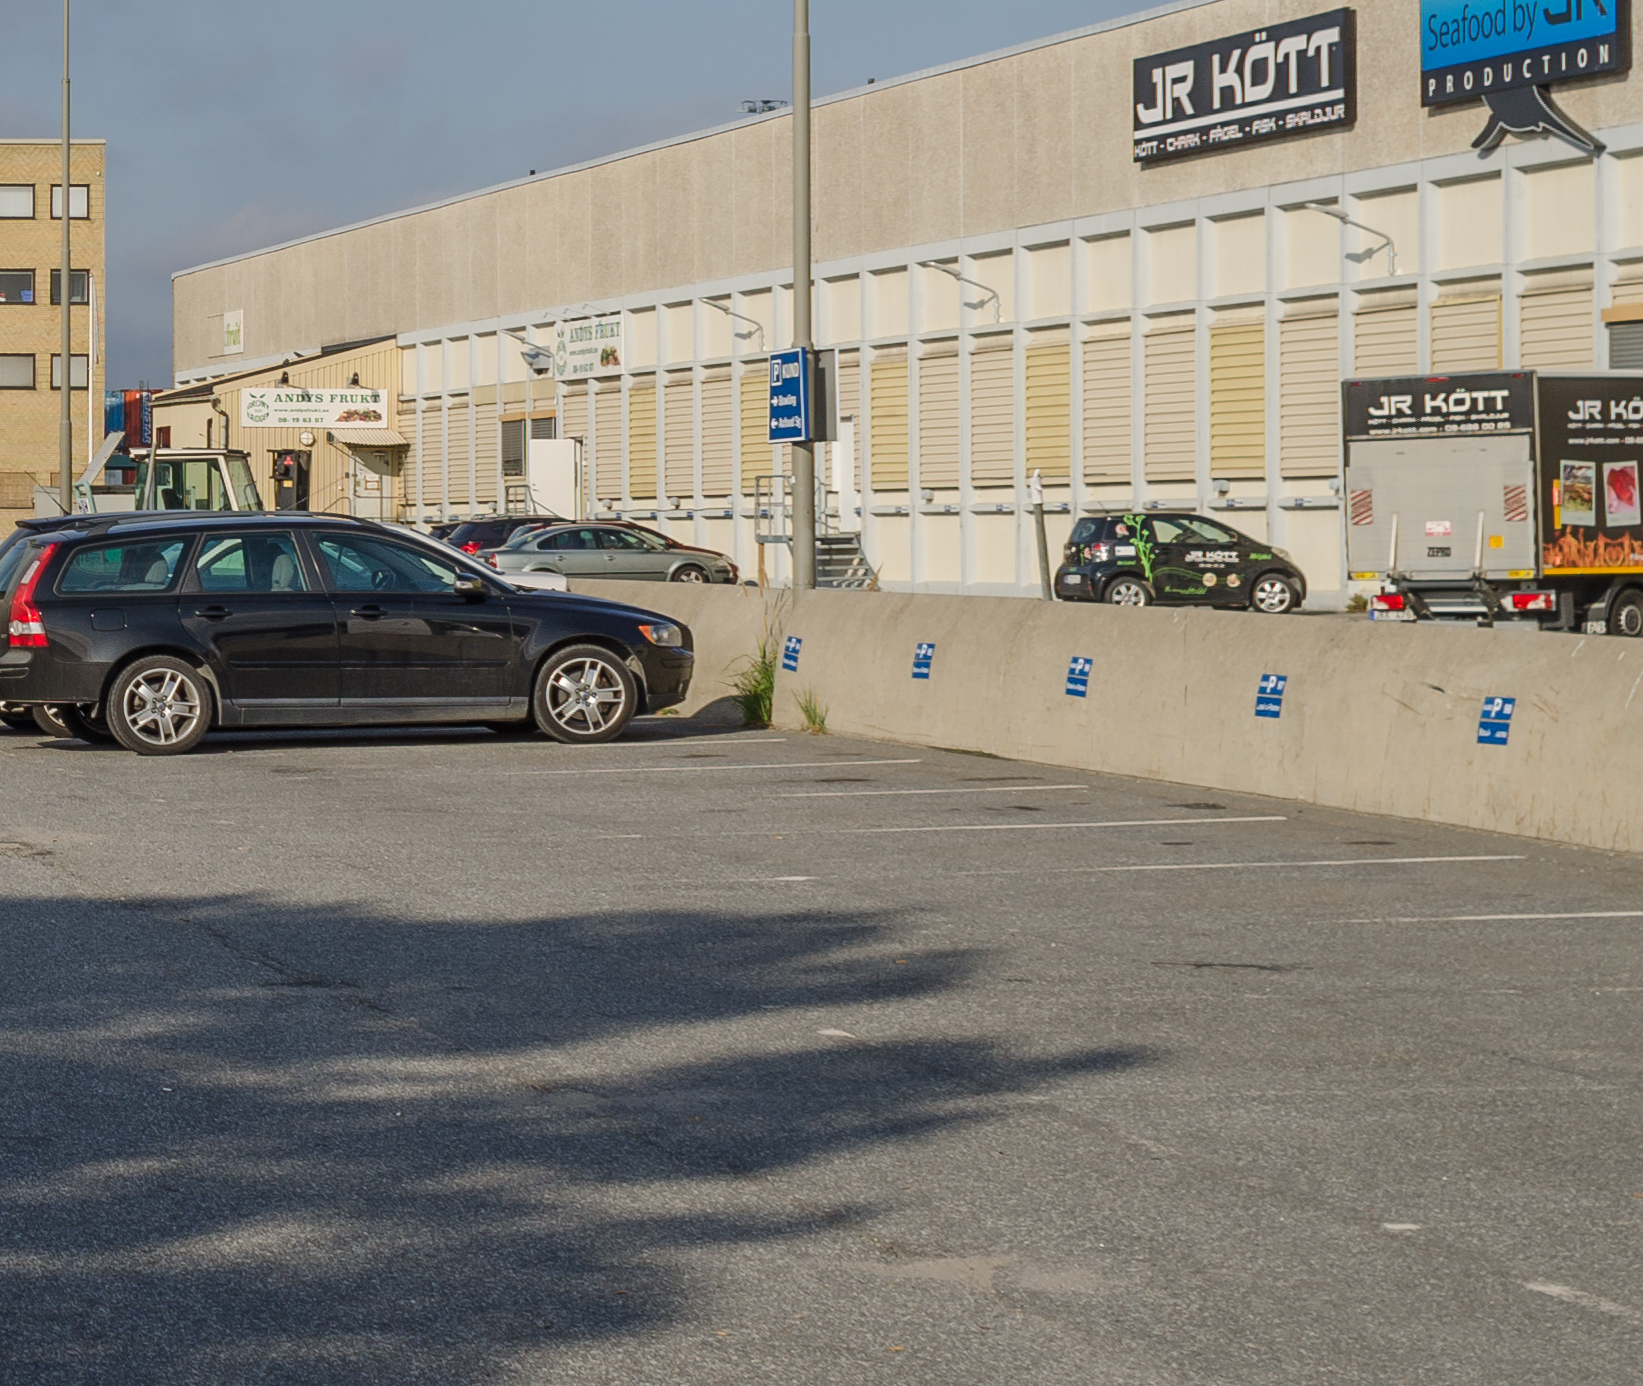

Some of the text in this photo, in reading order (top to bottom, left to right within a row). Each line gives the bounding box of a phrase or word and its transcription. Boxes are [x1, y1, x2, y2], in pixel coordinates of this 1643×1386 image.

[1136, 26, 1340, 124] JR KÖTT
[1428, 44, 1610, 97] PRODUCTION
[275, 393, 380, 403] ANDYS FRUKT
[1368, 388, 1510, 416] JR KÖTT
[1567, 399, 1602, 420] JR
